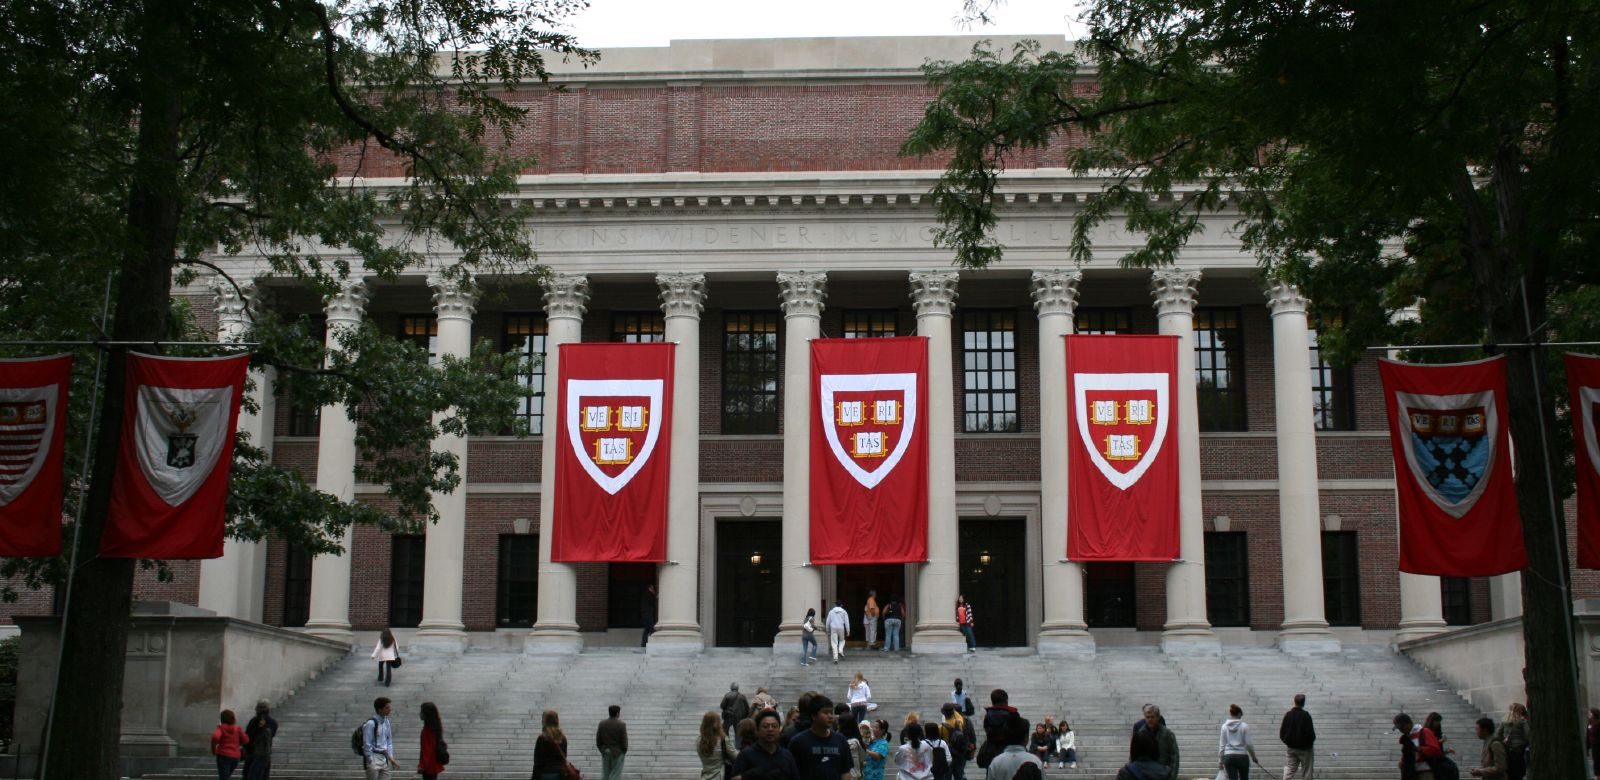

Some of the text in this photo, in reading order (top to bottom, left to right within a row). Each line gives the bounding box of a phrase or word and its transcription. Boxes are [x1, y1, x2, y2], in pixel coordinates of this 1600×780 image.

[533, 224, 1021, 246] LKINS WIDENER MEMOL
[843, 405, 892, 417] VE RI
[1097, 405, 1145, 416] VE RI
[588, 411, 638, 422] VE RI
[1414, 415, 1428, 425] VE
[1466, 416, 1481, 425] TAS
[859, 438, 880, 448] TAS
[1112, 440, 1133, 450] TAS
[603, 444, 625, 454] TAS
